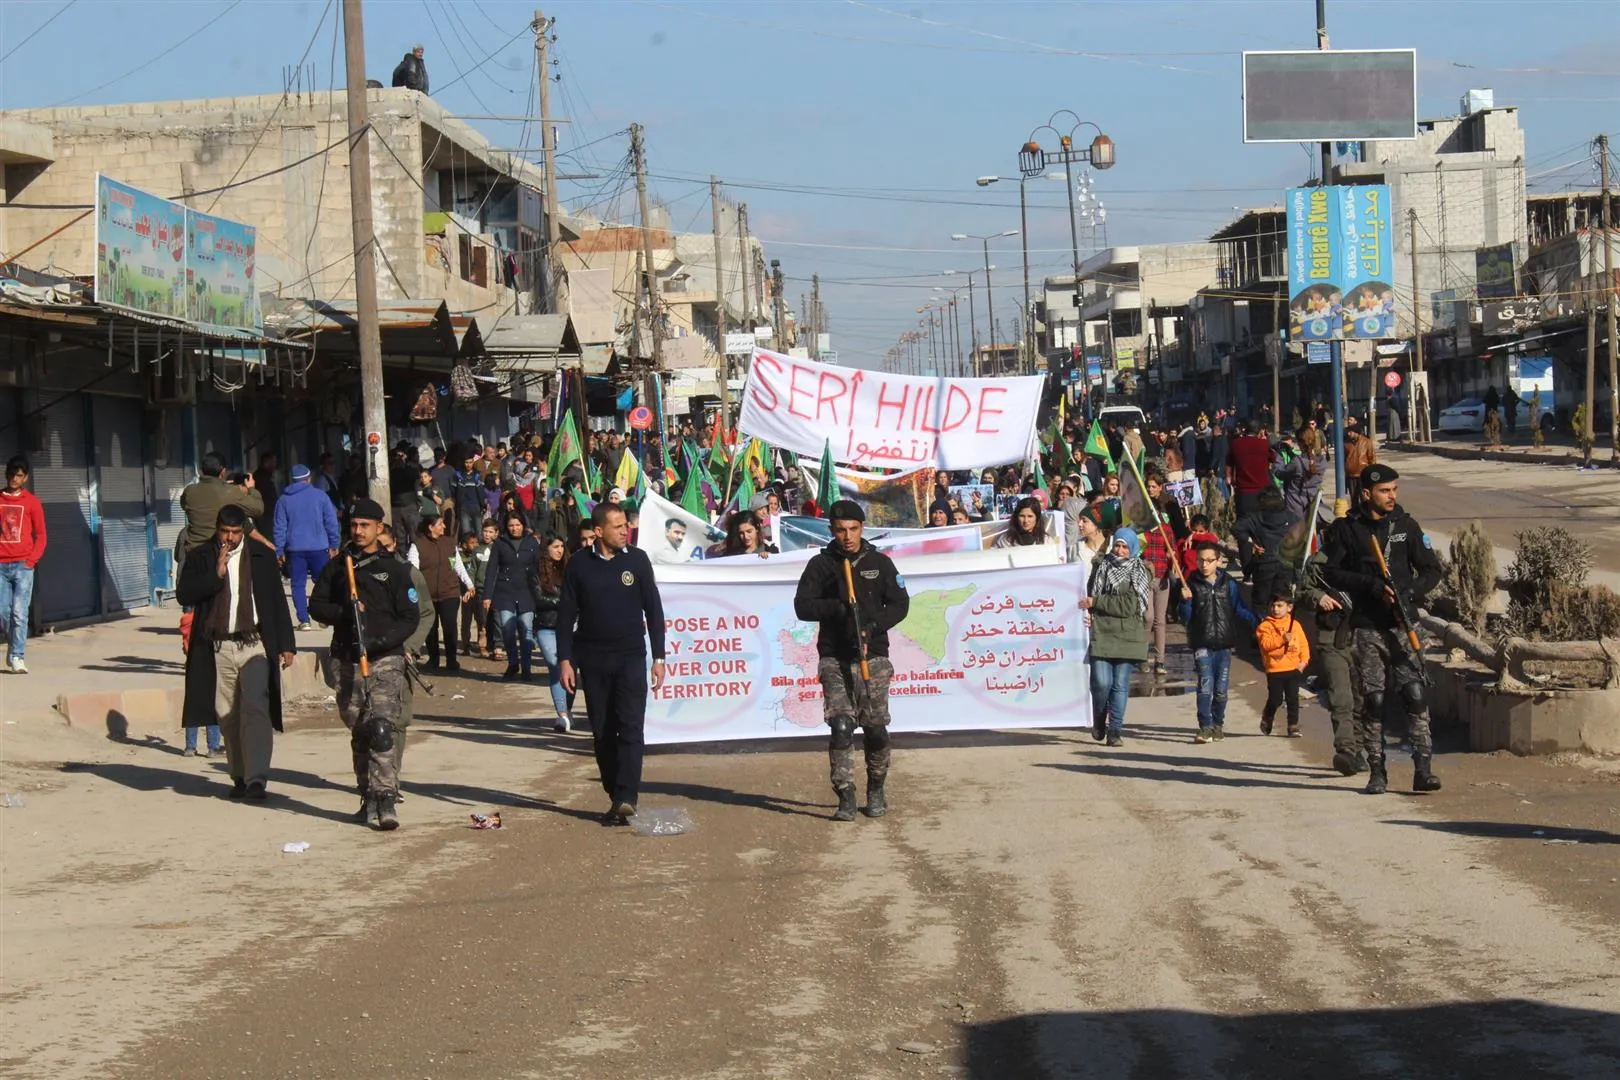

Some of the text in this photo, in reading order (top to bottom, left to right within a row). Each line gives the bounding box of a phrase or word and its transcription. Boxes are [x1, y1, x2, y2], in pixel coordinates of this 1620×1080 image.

[1307, 191, 1331, 279] Bajarê Xwe
[1360, 190, 1385, 276] مدينتك
[875, 381, 1008, 434] HILDE
[971, 595, 1055, 616] يجب فرض
[664, 615, 760, 633] POSE A NO
[960, 620, 1065, 642] منطقة حظر
[665, 659, 747, 677] VER OUR
[962, 647, 1064, 668] الطيران فوق
